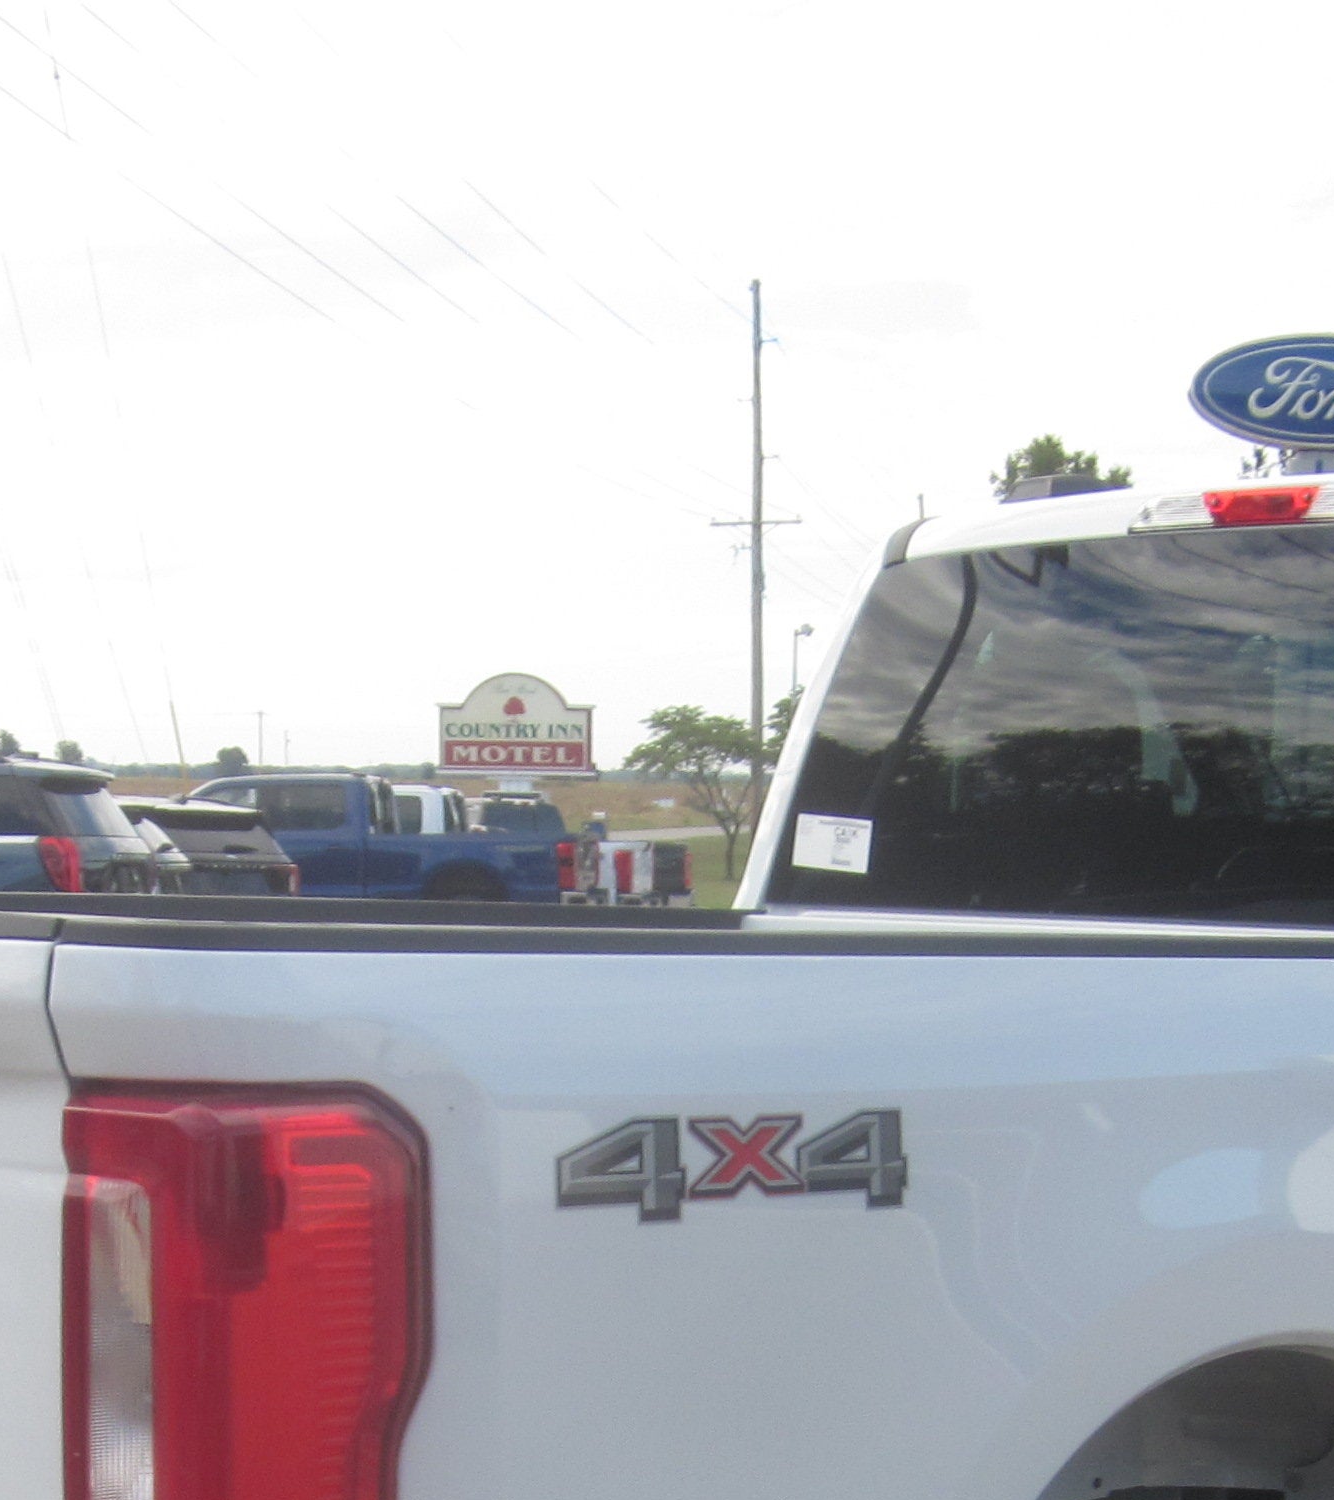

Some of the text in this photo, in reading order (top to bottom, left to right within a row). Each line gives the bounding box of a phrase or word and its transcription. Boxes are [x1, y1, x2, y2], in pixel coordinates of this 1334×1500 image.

[445, 723, 583, 739] COUNTRY INN
[452, 745, 576, 763] MOTEL
